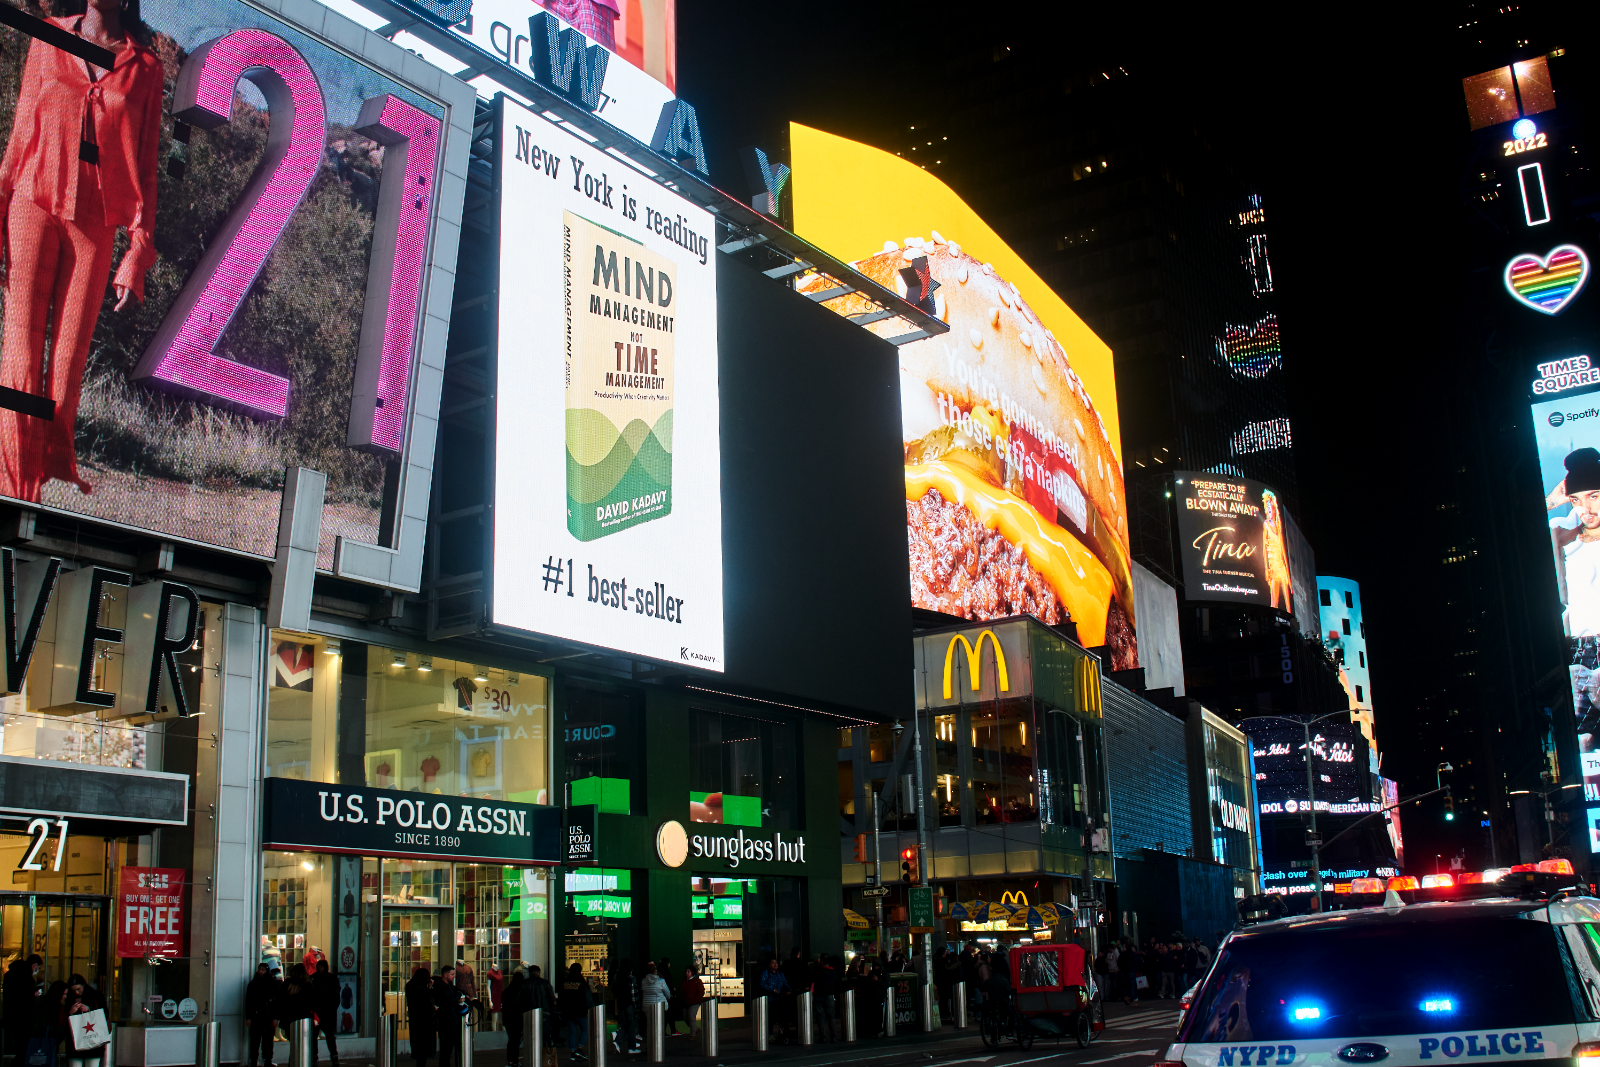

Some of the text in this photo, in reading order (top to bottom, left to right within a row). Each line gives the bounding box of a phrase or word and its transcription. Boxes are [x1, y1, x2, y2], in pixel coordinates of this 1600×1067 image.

[1503, 133, 1548, 157] 2022
[515, 125, 709, 266] New York is reading
[135, 28, 443, 454] 21
[593, 244, 673, 308] MIND
[589, 293, 674, 333] MANAGEMENT
[630, 331, 643, 344] NOT
[614, 341, 658, 376] TIME
[1538, 356, 1590, 378] TIMES
[605, 372, 665, 390] MANAGEMENT
[1533, 368, 1600, 394] SQUARE
[594, 391, 623, 401] Productivity
[943, 343, 1080, 471] You're gonna need
[1566, 408, 1600, 421] Spotify
[937, 391, 1088, 515] those extra napkins
[1198, 489, 1244, 502] ECSTATICALLY
[1227, 484, 1237, 492] TO
[1237, 485, 1246, 494] BE
[597, 489, 667, 521] DAVID KADAVY
[1186, 497, 1228, 512] BLOWN
[1193, 526, 1257, 566] Tina
[542, 556, 684, 624] #1 best-seller
[1202, 583, 1259, 596] TinaOnBroadway.com
[690, 651, 716, 663] KADAVY
[1280, 633, 1294, 684] 1500
[484, 686, 511, 713] $30
[1267, 743, 1291, 756] Idol
[318, 791, 531, 836] U.S. POLO ASSN.
[1220, 798, 1234, 829] OLD
[1261, 803, 1283, 813] IDOL
[395, 832, 461, 848] SINCE 1890
[569, 825, 584, 835] U.S.
[569, 834, 591, 844] POLO
[22, 818, 68, 872] 21
[568, 843, 592, 853] ASSN.
[692, 829, 806, 868] sunglass hut
[1263, 870, 1285, 881] clash
[1288, 871, 1308, 879] over
[1339, 869, 1369, 879] military
[126, 894, 139, 903] BUY
[155, 895, 168, 904] GET
[168, 895, 180, 904] ONE
[125, 906, 180, 935] FREE
[898, 980, 910, 994] 25
[1217, 1044, 1297, 1067] NYPD
[1419, 1031, 1544, 1060] POLICE
